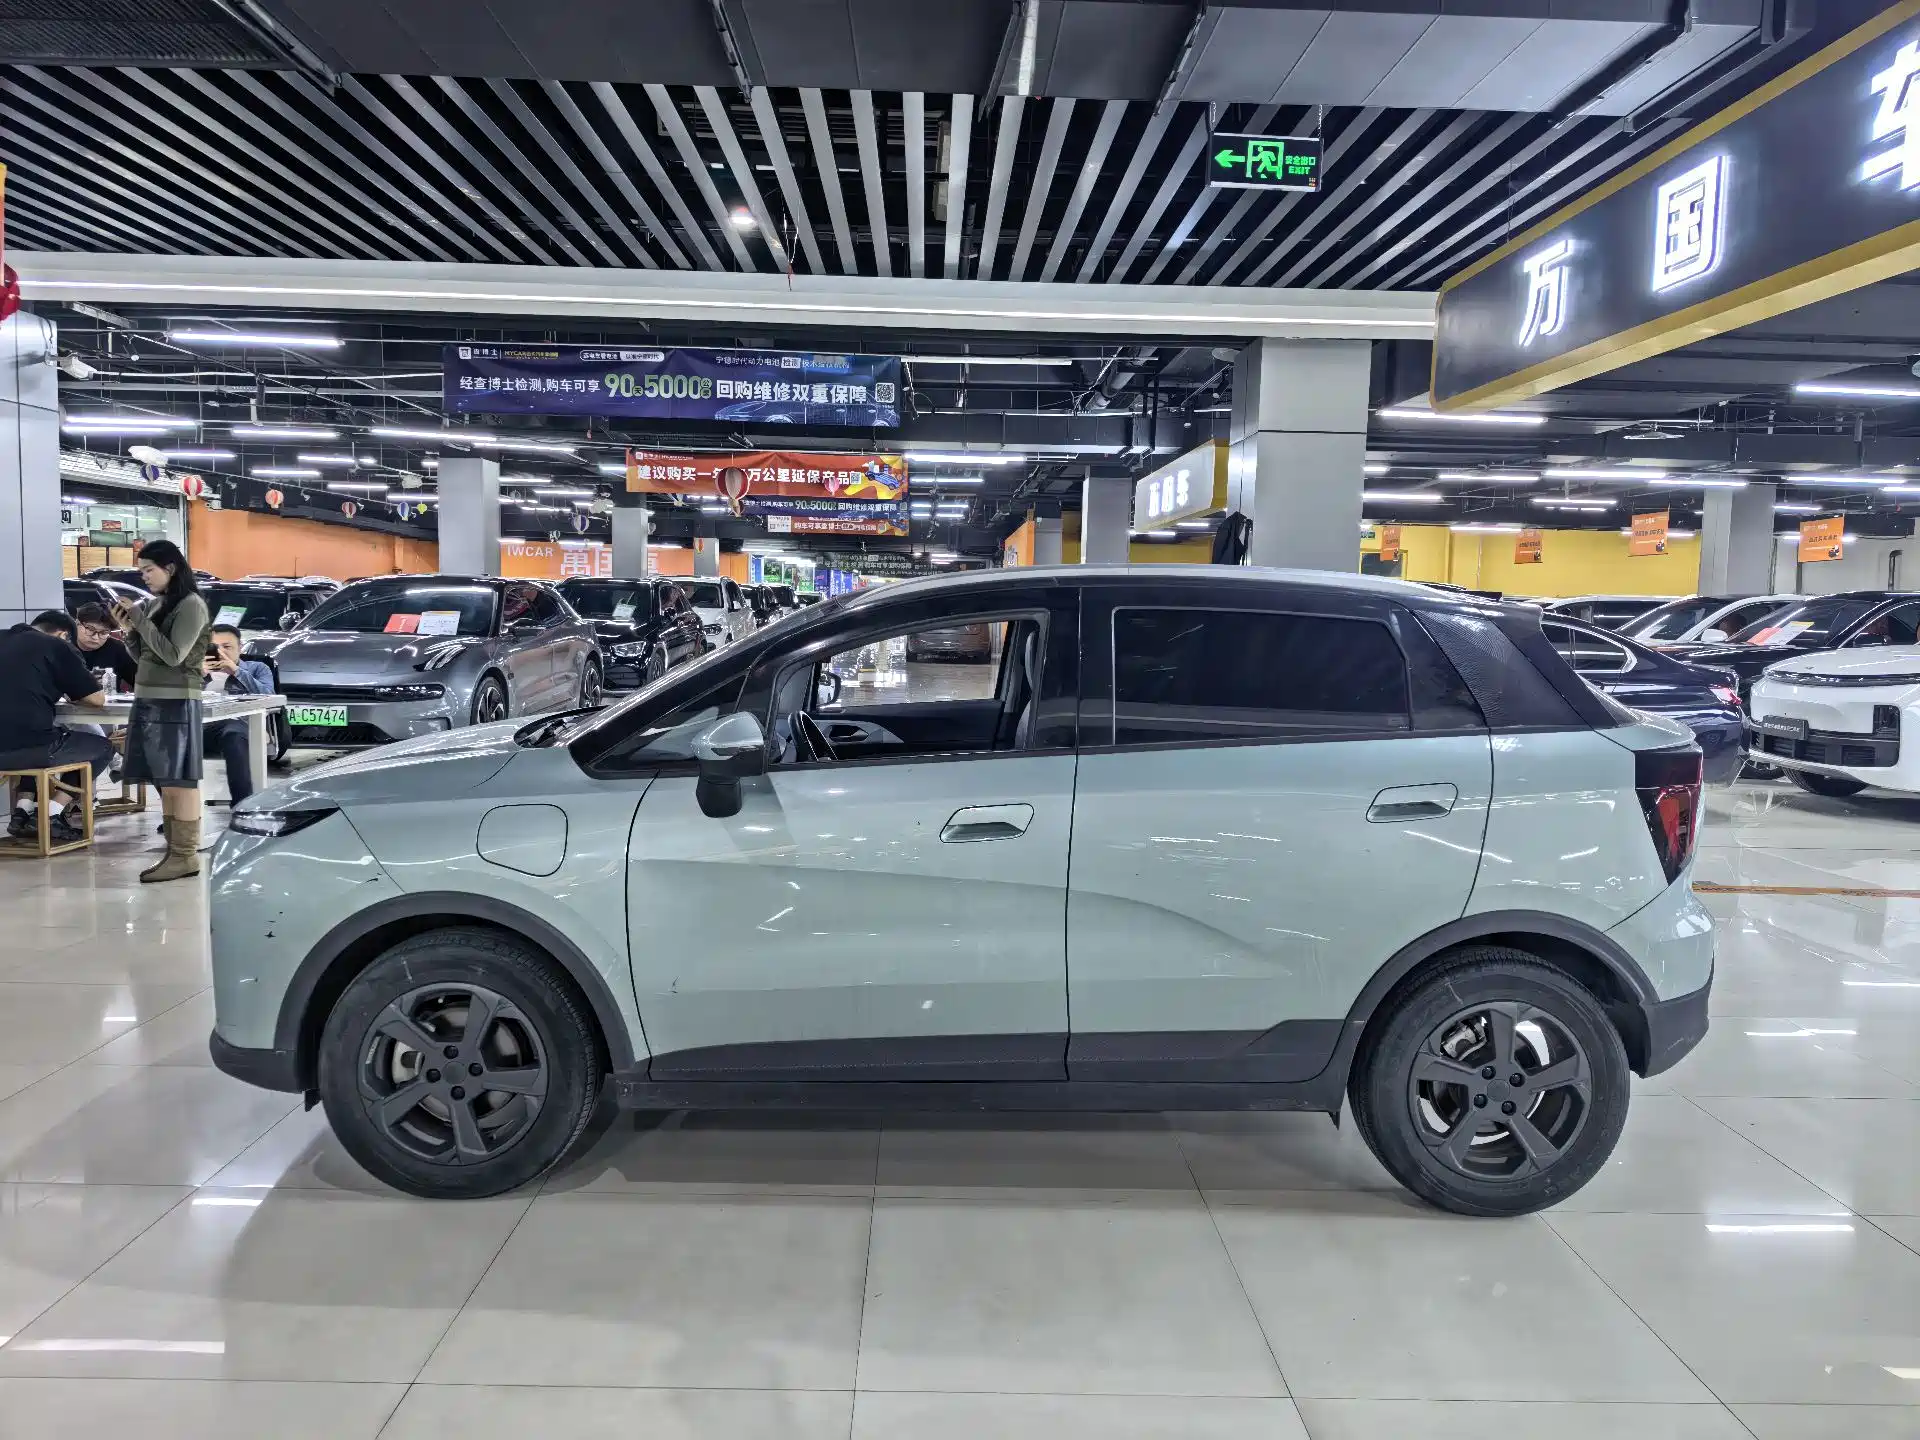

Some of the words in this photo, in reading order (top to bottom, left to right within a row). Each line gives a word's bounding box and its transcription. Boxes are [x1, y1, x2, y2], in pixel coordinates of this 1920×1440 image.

[1285, 155, 1316, 166] 安全出口
[1288, 166, 1311, 175] EXIT
[716, 379, 867, 404] 回购维修双重保障
[507, 544, 553, 557] IWCAR
